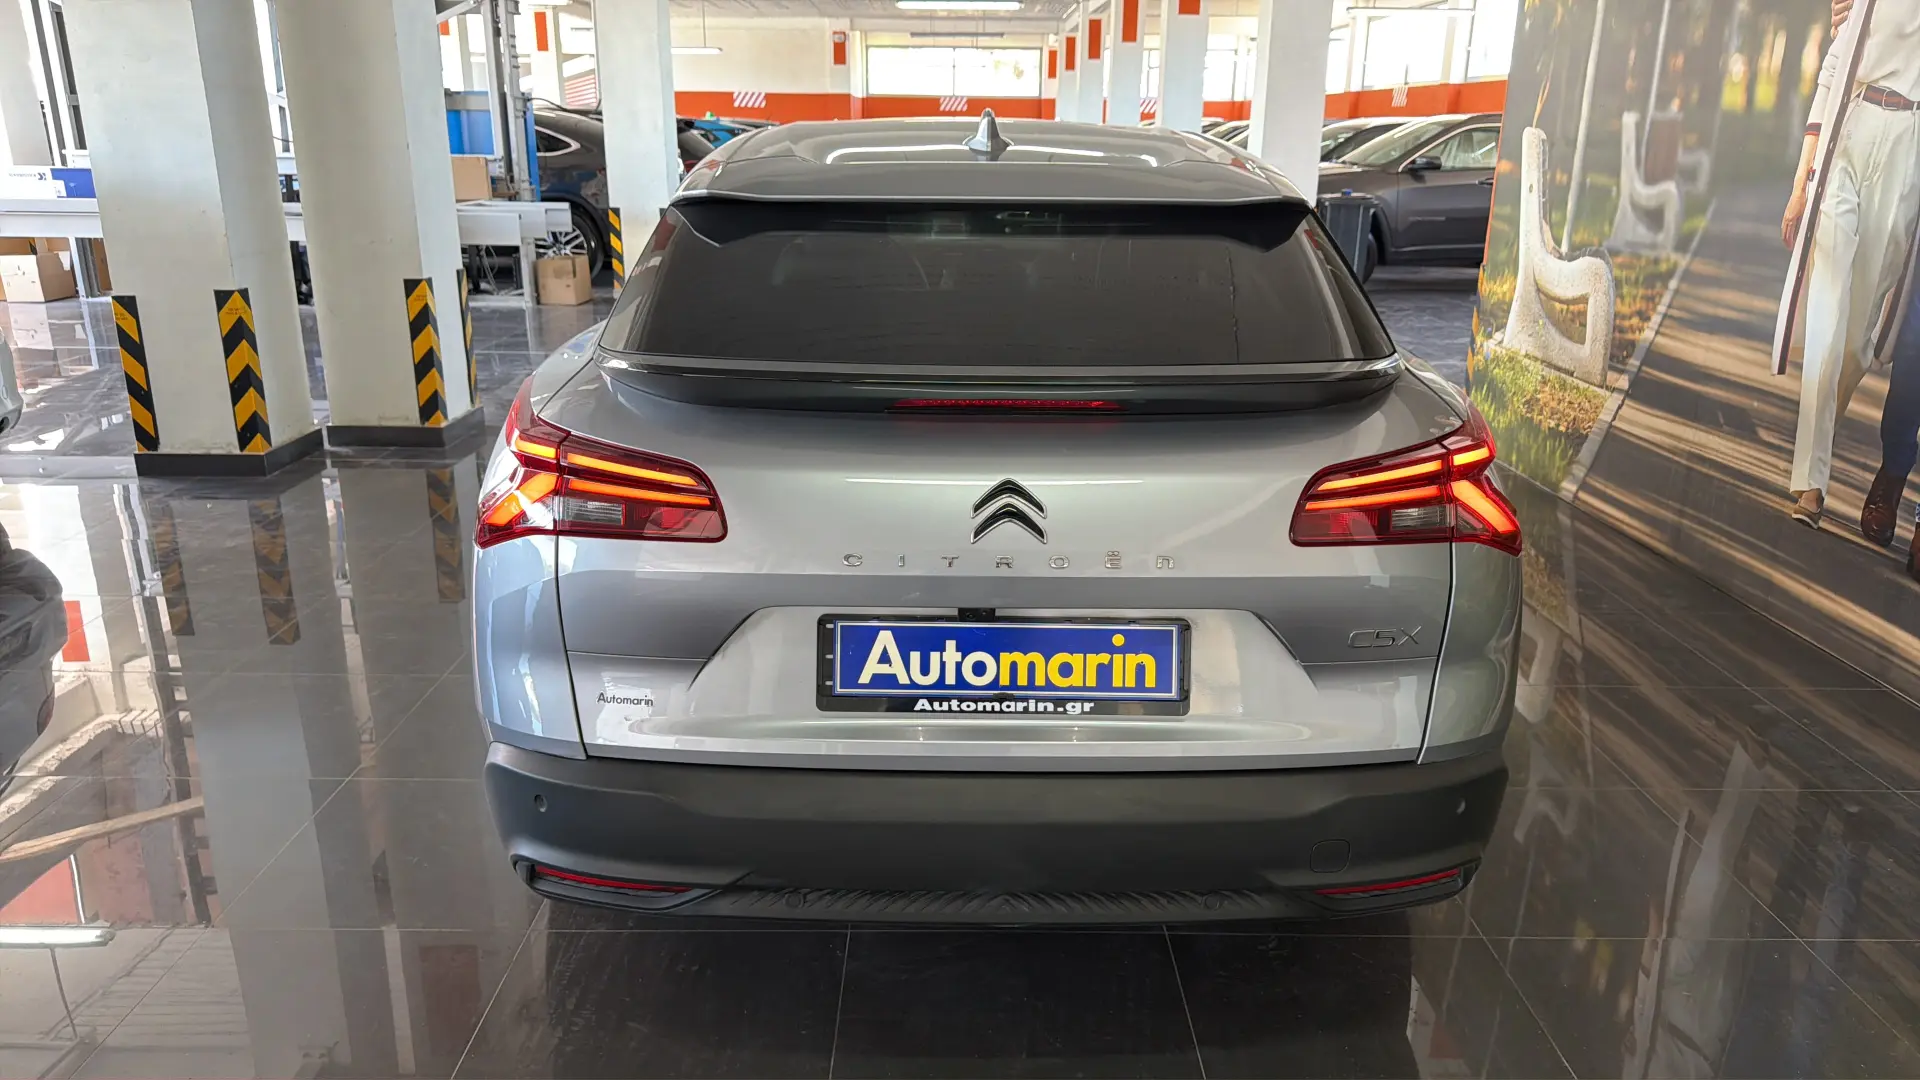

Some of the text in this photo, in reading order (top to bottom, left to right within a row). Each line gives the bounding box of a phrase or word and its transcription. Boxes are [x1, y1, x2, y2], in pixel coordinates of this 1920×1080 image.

[857, 630, 1156, 688] Automarin
[597, 692, 654, 707] Automarin
[913, 698, 1095, 715] Automarin.gr
